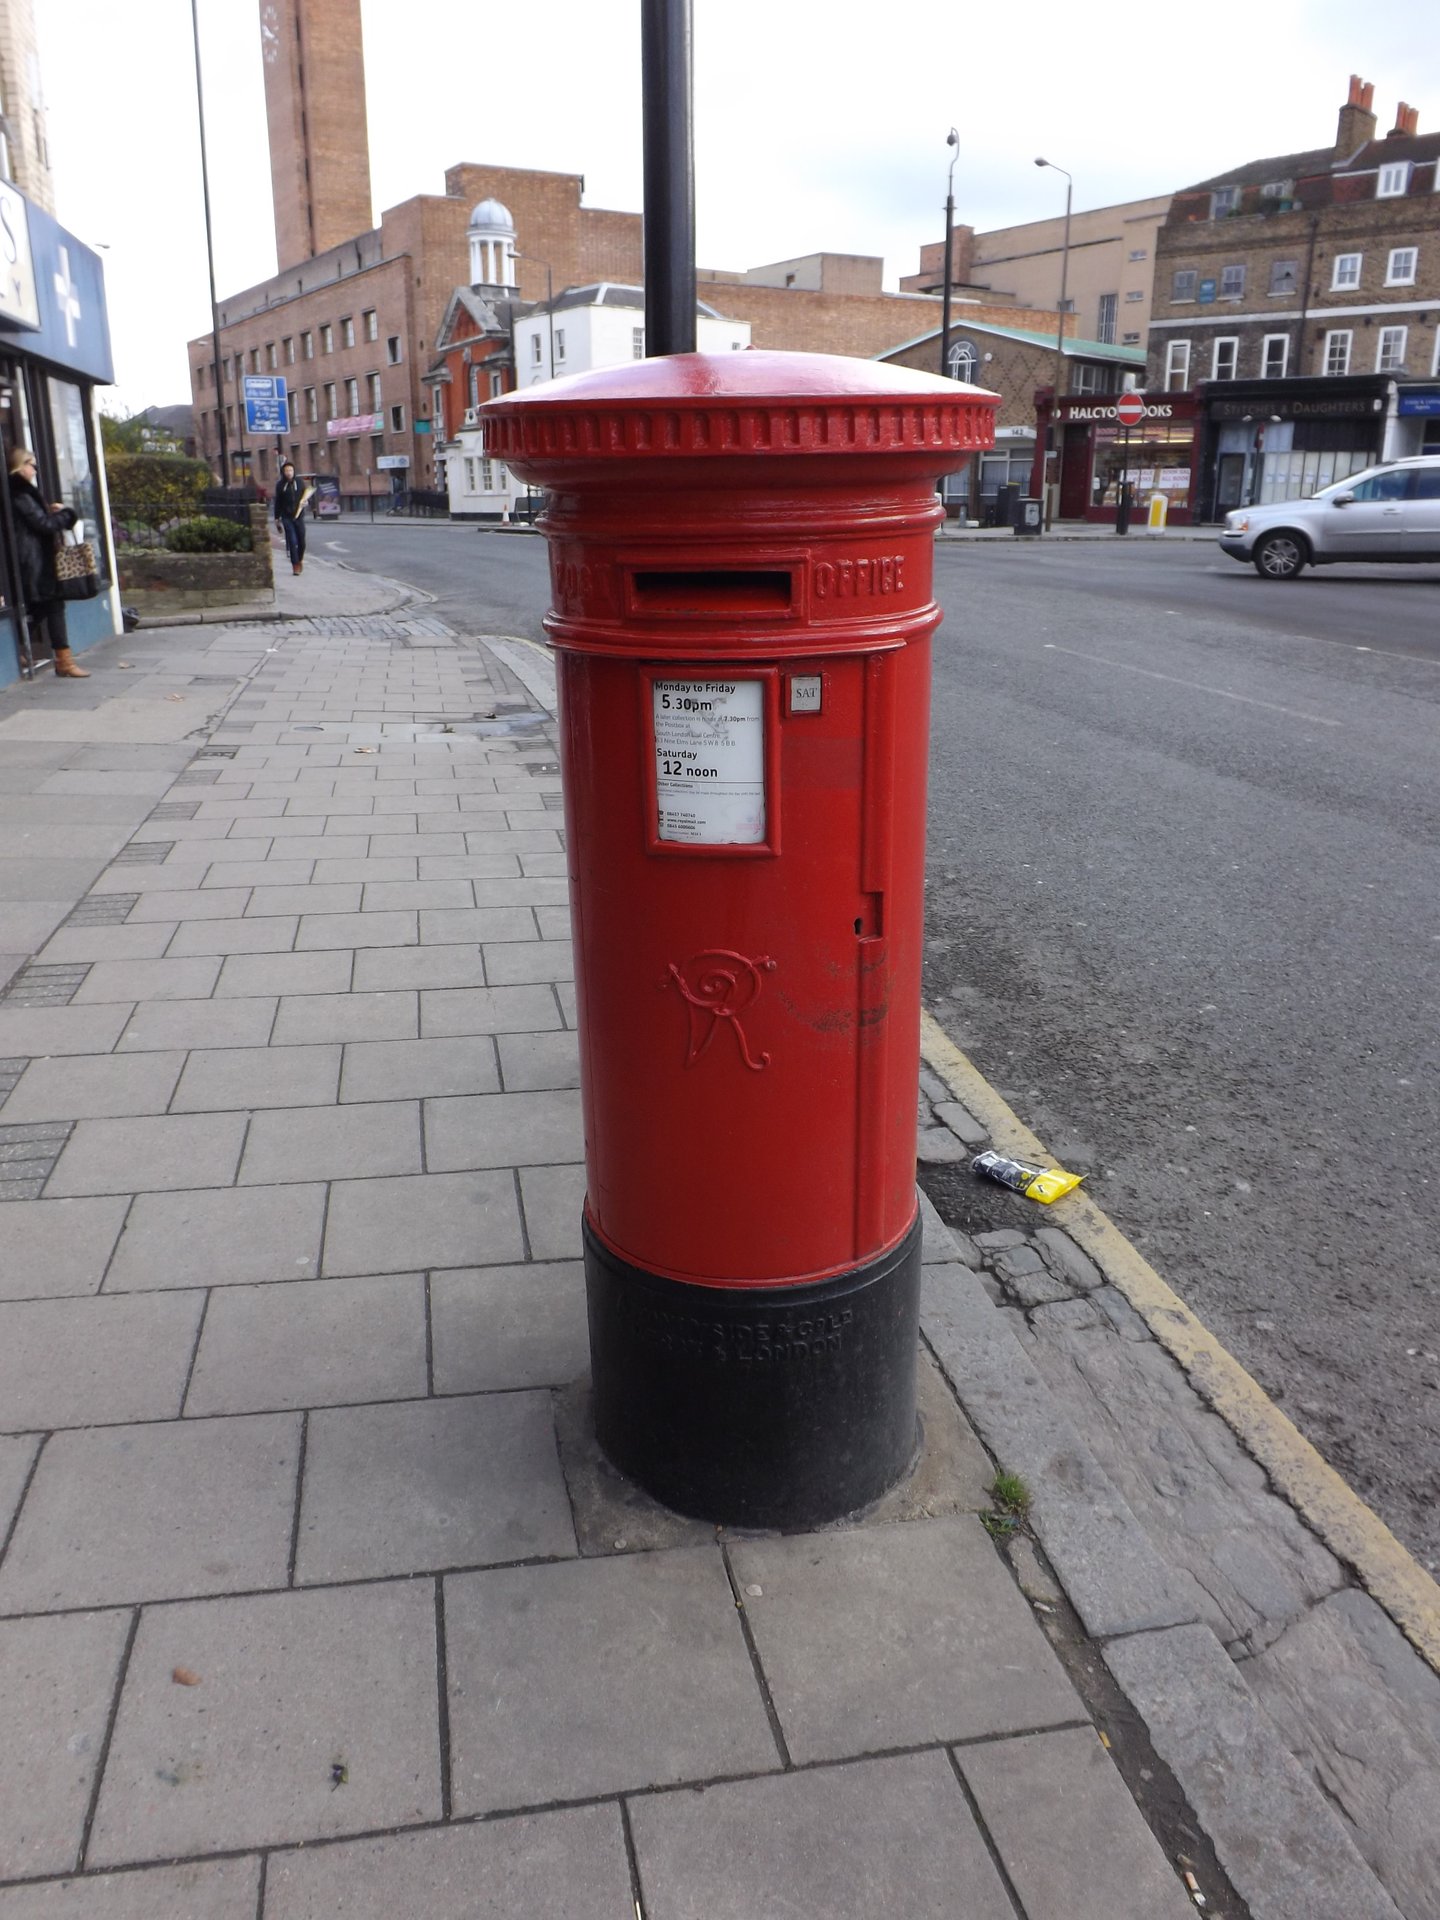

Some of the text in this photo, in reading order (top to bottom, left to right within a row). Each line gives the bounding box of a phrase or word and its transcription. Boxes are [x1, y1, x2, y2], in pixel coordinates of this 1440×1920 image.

[1069, 405, 1119, 420] HALCYO
[1292, 401, 1366, 413] DAUGHTERS
[815, 555, 904, 598] OFFICE
[655, 682, 736, 694] Monday to Friday
[796, 687, 818, 698] SAT
[662, 694, 712, 712] 5.30pm
[657, 748, 698, 760] Saturday
[662, 760, 718, 777] 12 noon
